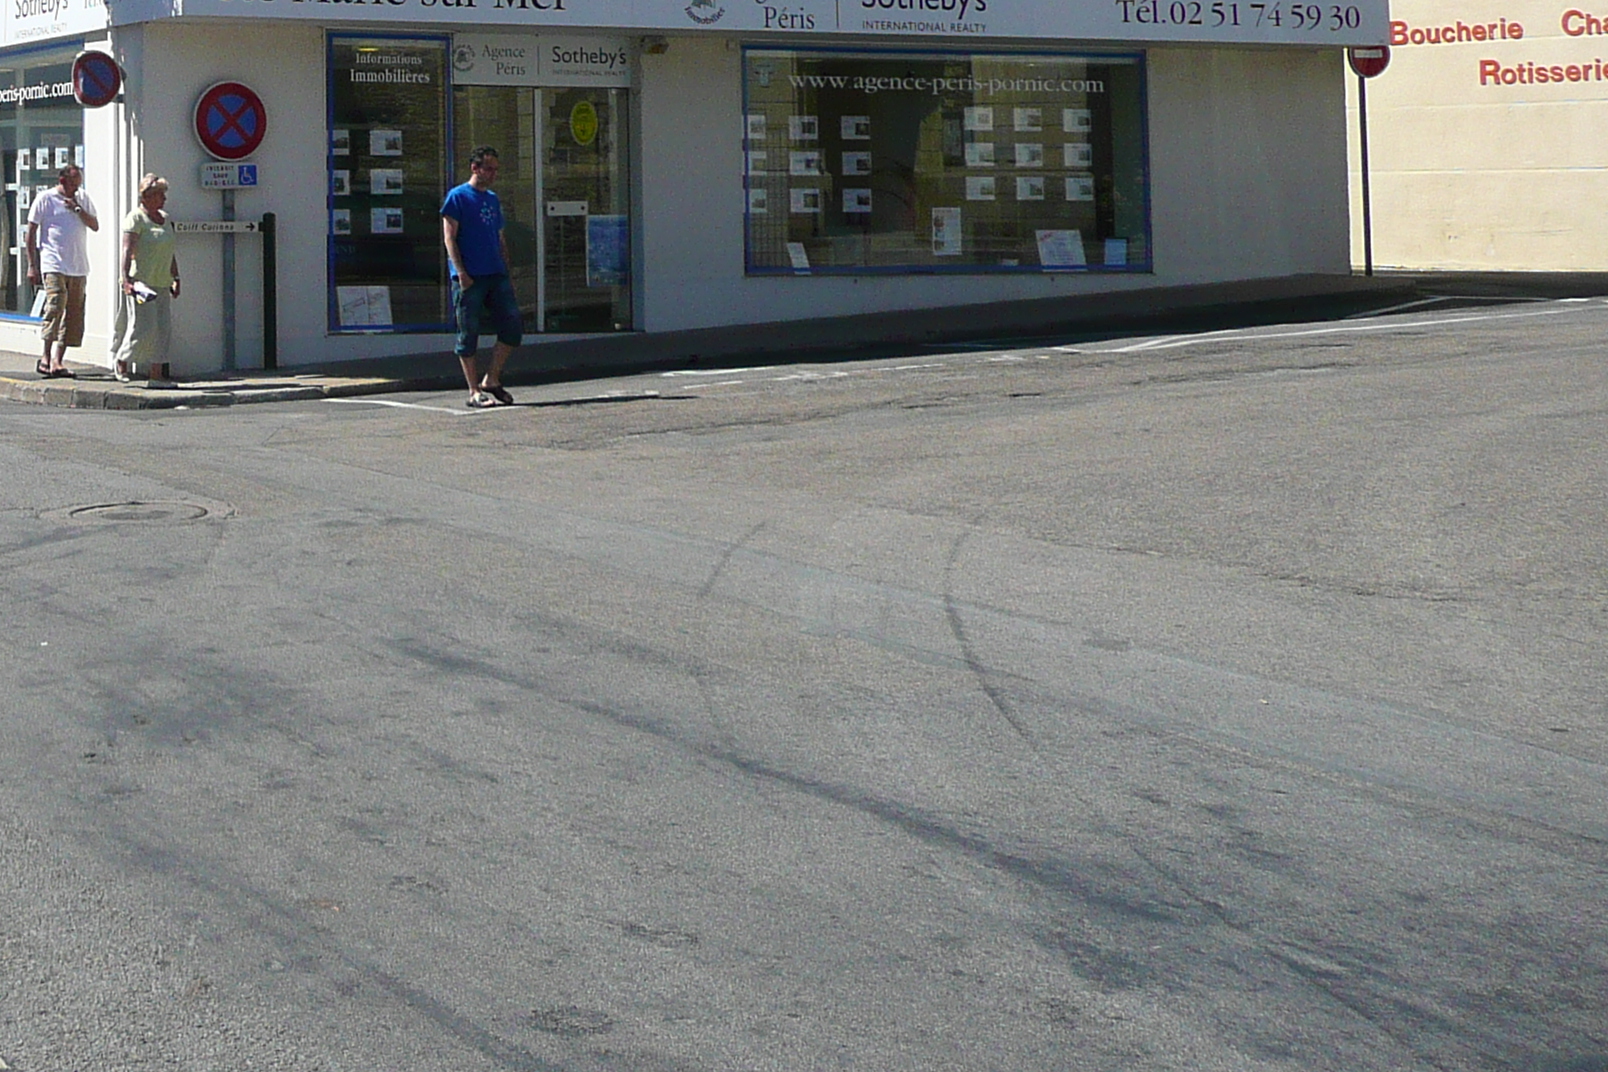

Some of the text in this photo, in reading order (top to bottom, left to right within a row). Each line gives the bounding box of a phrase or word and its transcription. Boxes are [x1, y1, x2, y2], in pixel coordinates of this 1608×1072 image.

[764, 6, 815, 29] Péris
[1211, 1, 1241, 27] 51
[1250, 1, 1283, 27] 74
[1291, 4, 1322, 30] 59
[1330, 5, 1361, 31] 30
[862, 20, 987, 33] INTERNATIONAL REALTY
[1390, 17, 1524, 46] Boucherie
[355, 52, 423, 65] Informations
[482, 45, 525, 61] Agence
[552, 46, 626, 69] Sotheby's
[350, 68, 430, 84] Immobilières
[496, 62, 525, 76] Péris
